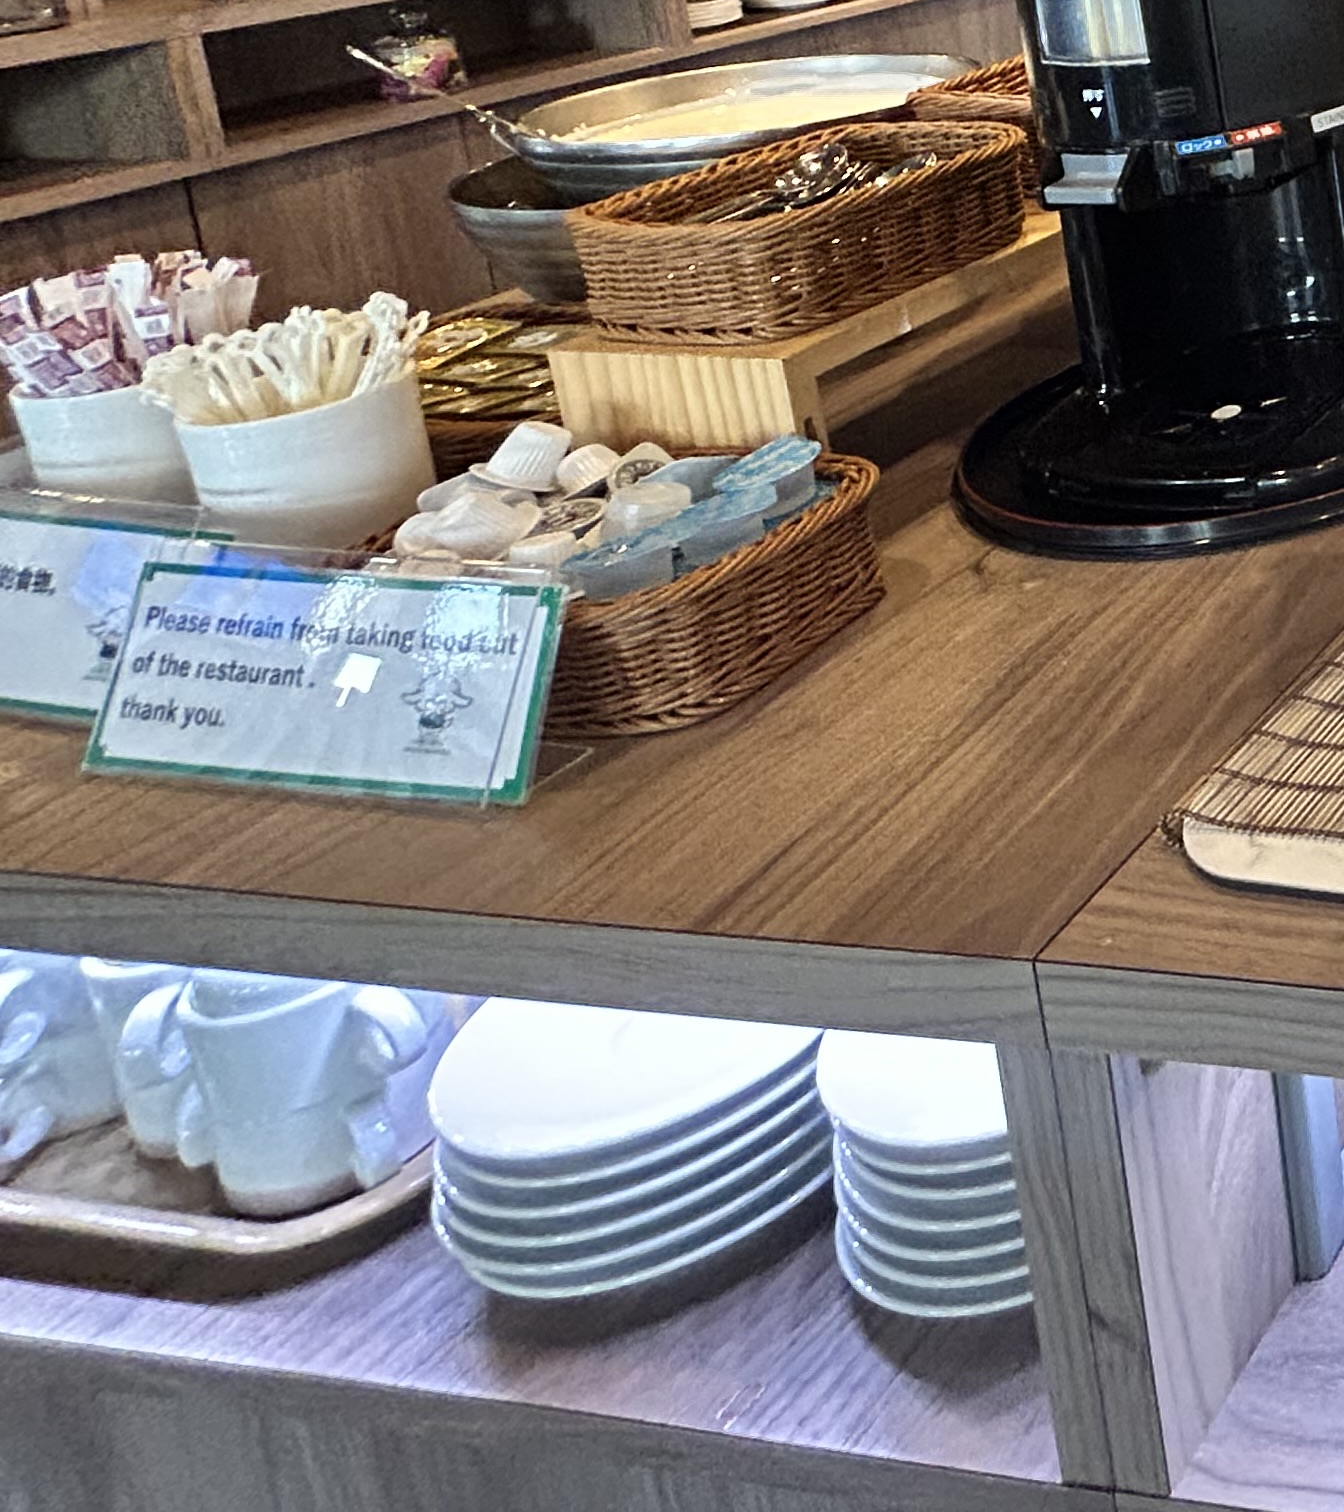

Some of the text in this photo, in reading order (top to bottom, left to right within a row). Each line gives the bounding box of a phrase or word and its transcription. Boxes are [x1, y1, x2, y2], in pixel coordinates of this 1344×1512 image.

[144, 605, 211, 634] Please
[216, 615, 283, 641] refrain
[346, 622, 416, 655] taking
[132, 650, 156, 674] of
[158, 653, 190, 678] the
[194, 658, 304, 689] restaurant
[119, 694, 226, 730] thank you.
